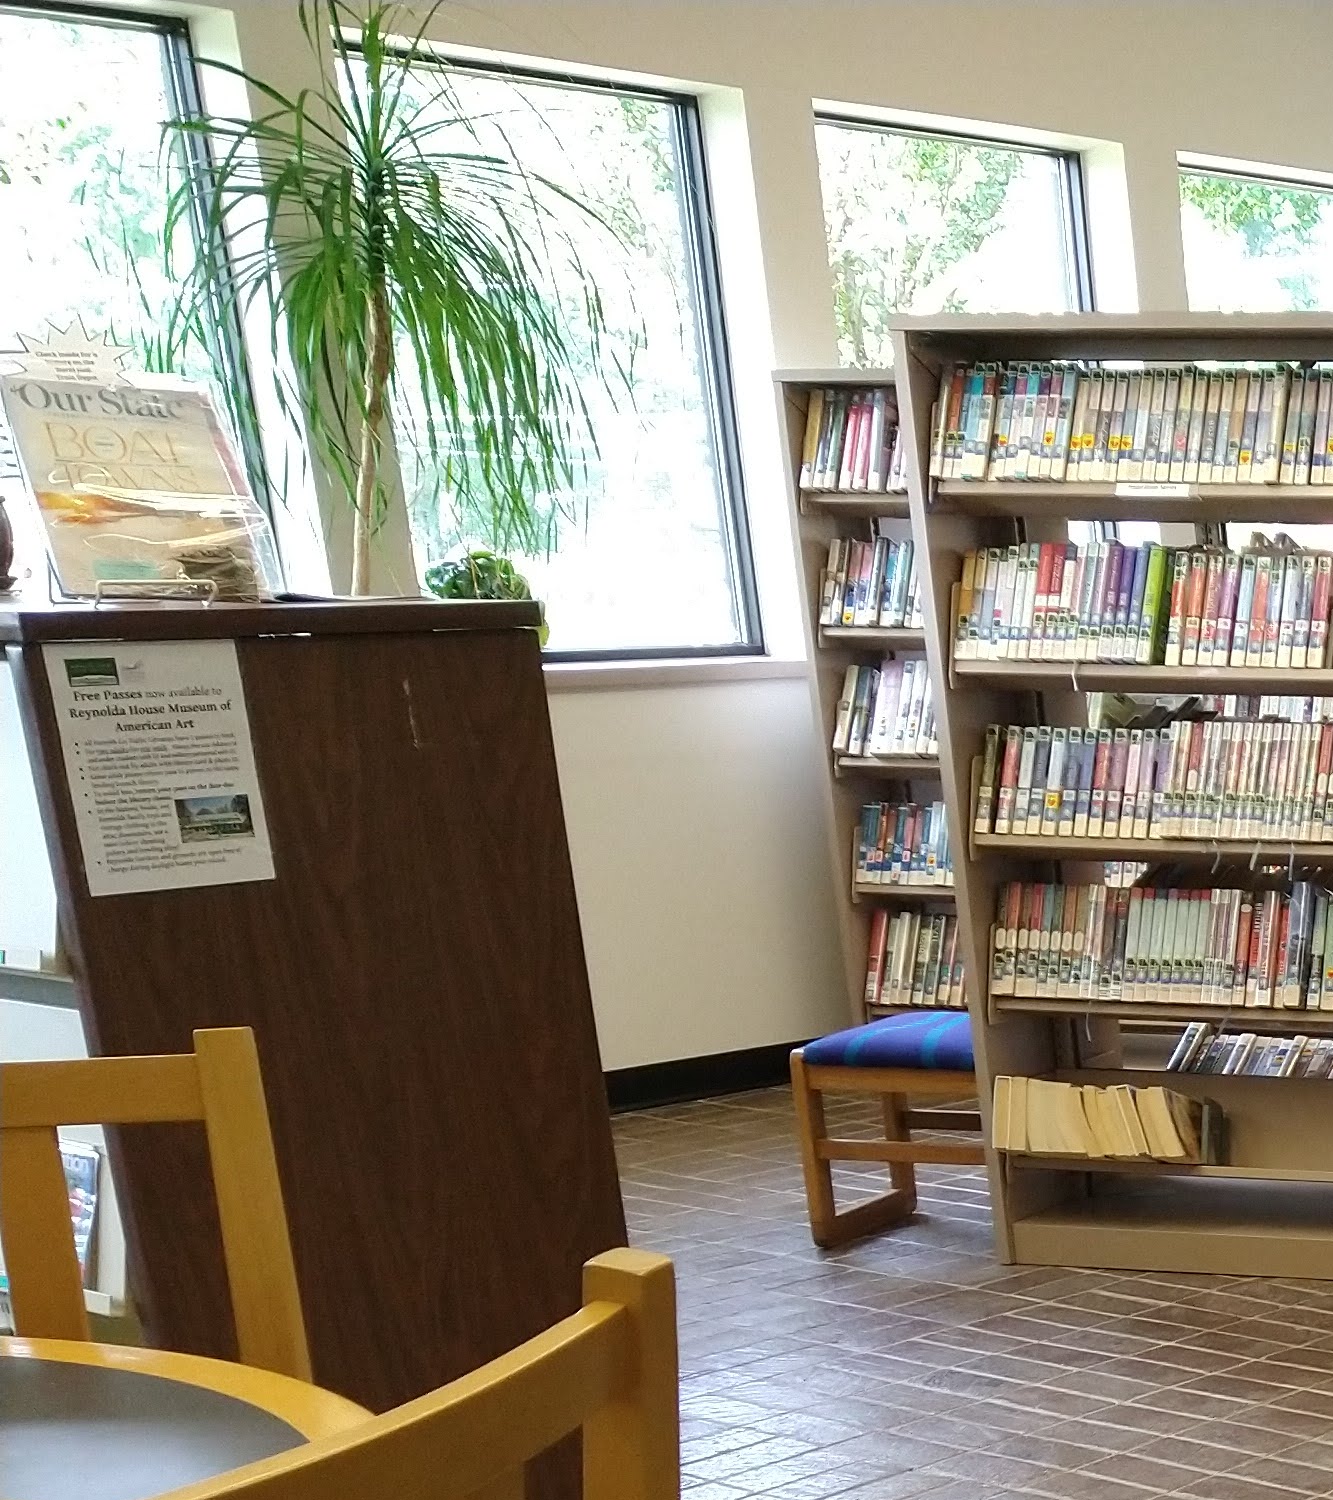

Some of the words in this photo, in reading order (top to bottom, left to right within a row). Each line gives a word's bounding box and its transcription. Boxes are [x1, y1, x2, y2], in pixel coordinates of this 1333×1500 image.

[12, 382, 92, 413] Our
[99, 388, 184, 419] State
[72, 690, 101, 702] Free
[103, 688, 144, 701] Passes
[145, 690, 167, 699] now
[168, 685, 210, 699] available
[211, 686, 223, 696] to
[69, 703, 127, 721] Reynolda
[128, 703, 166, 716] House
[167, 702, 218, 714] Museum
[219, 699, 233, 712] of
[115, 720, 172, 733] American
[174, 718, 196, 731] Art
